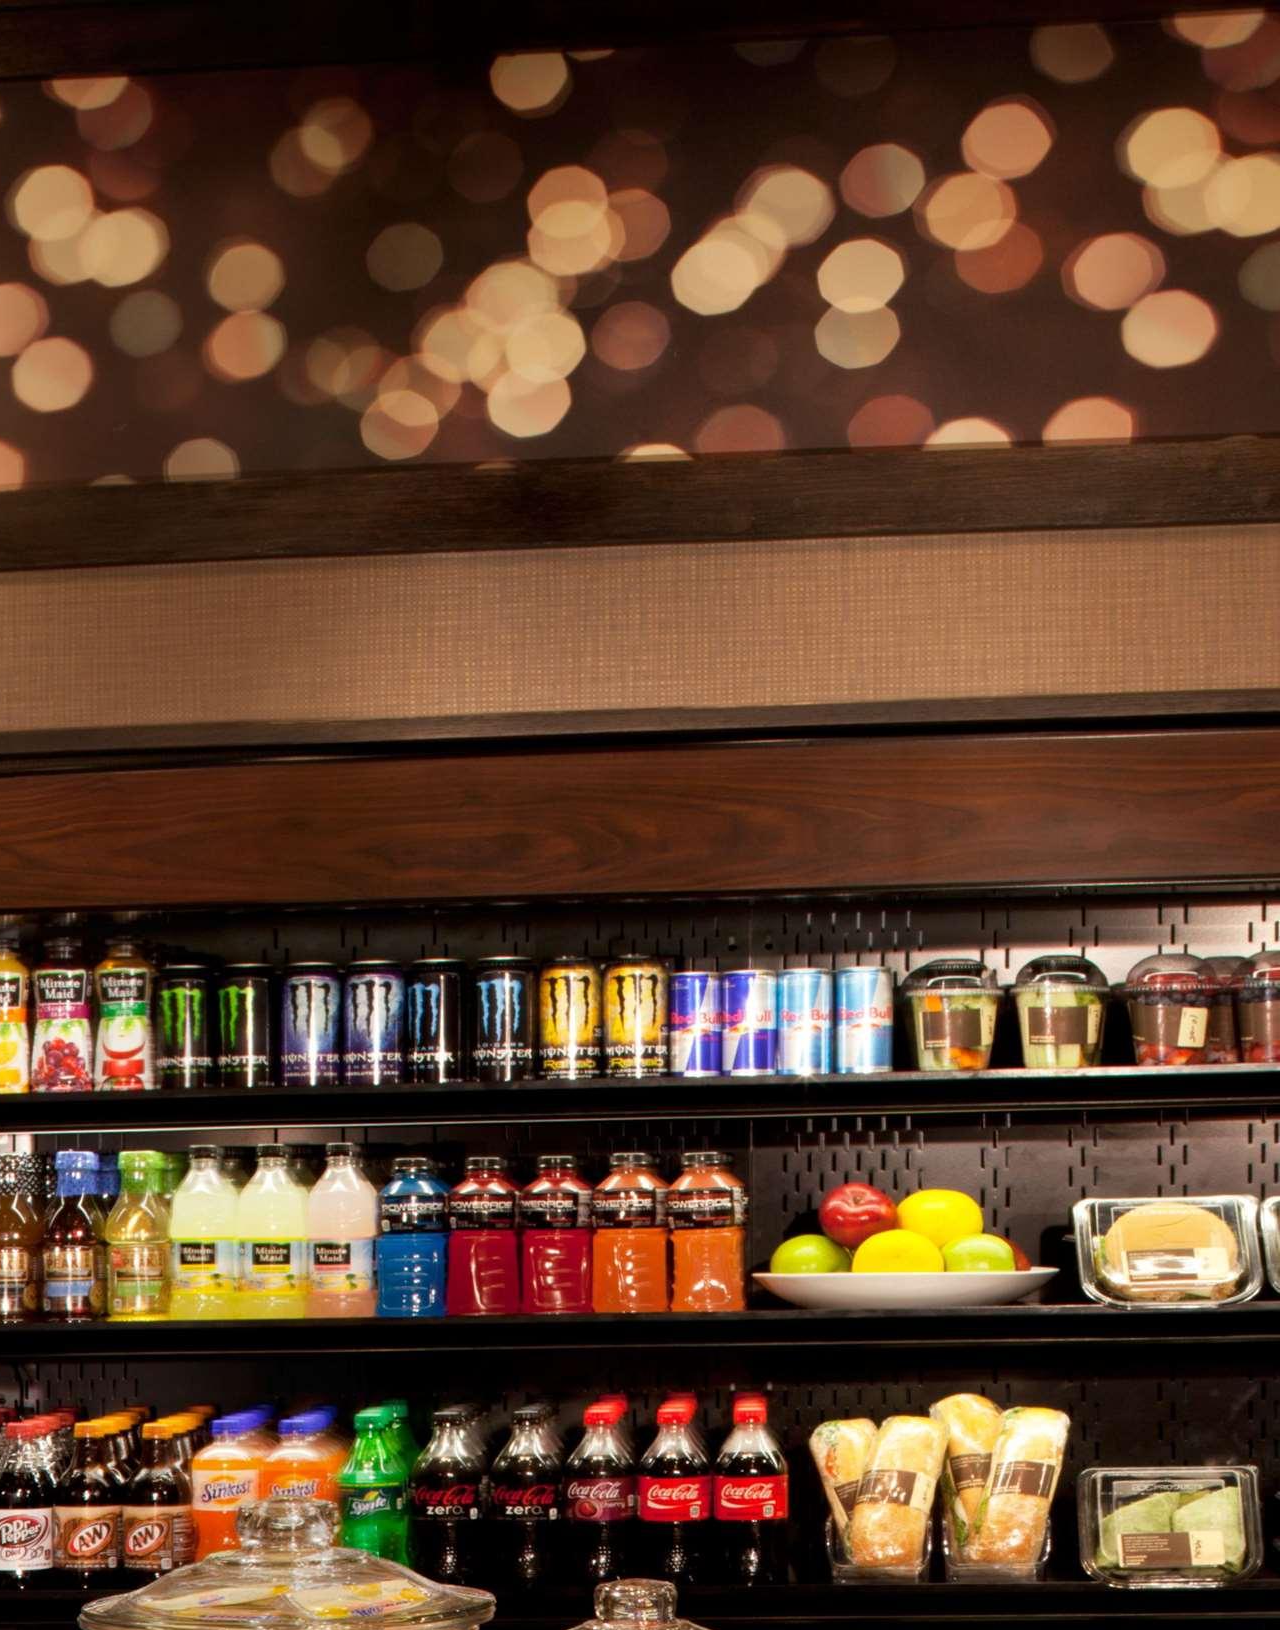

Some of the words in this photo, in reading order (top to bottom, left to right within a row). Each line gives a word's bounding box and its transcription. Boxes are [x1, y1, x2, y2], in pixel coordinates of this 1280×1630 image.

[39, 978, 81, 990] Minute
[102, 977, 143, 988] Minute
[45, 988, 74, 1000] Maid
[108, 987, 137, 998] Maid
[870, 1007, 891, 1020] Bull
[473, 1049, 532, 1060] MONSTER
[382, 1203, 442, 1212] POWERADE
[521, 1200, 575, 1210] WERADE
[201, 1479, 253, 1503] Sunkist
[648, 1482, 701, 1500] Coca-Cola
[721, 1482, 775, 1500] Coca-Cola
[352, 1496, 387, 1515] Sprite
[426, 1504, 464, 1516] zero
[505, 1505, 542, 1516] zero
[1, 1522, 42, 1545] Pepper
